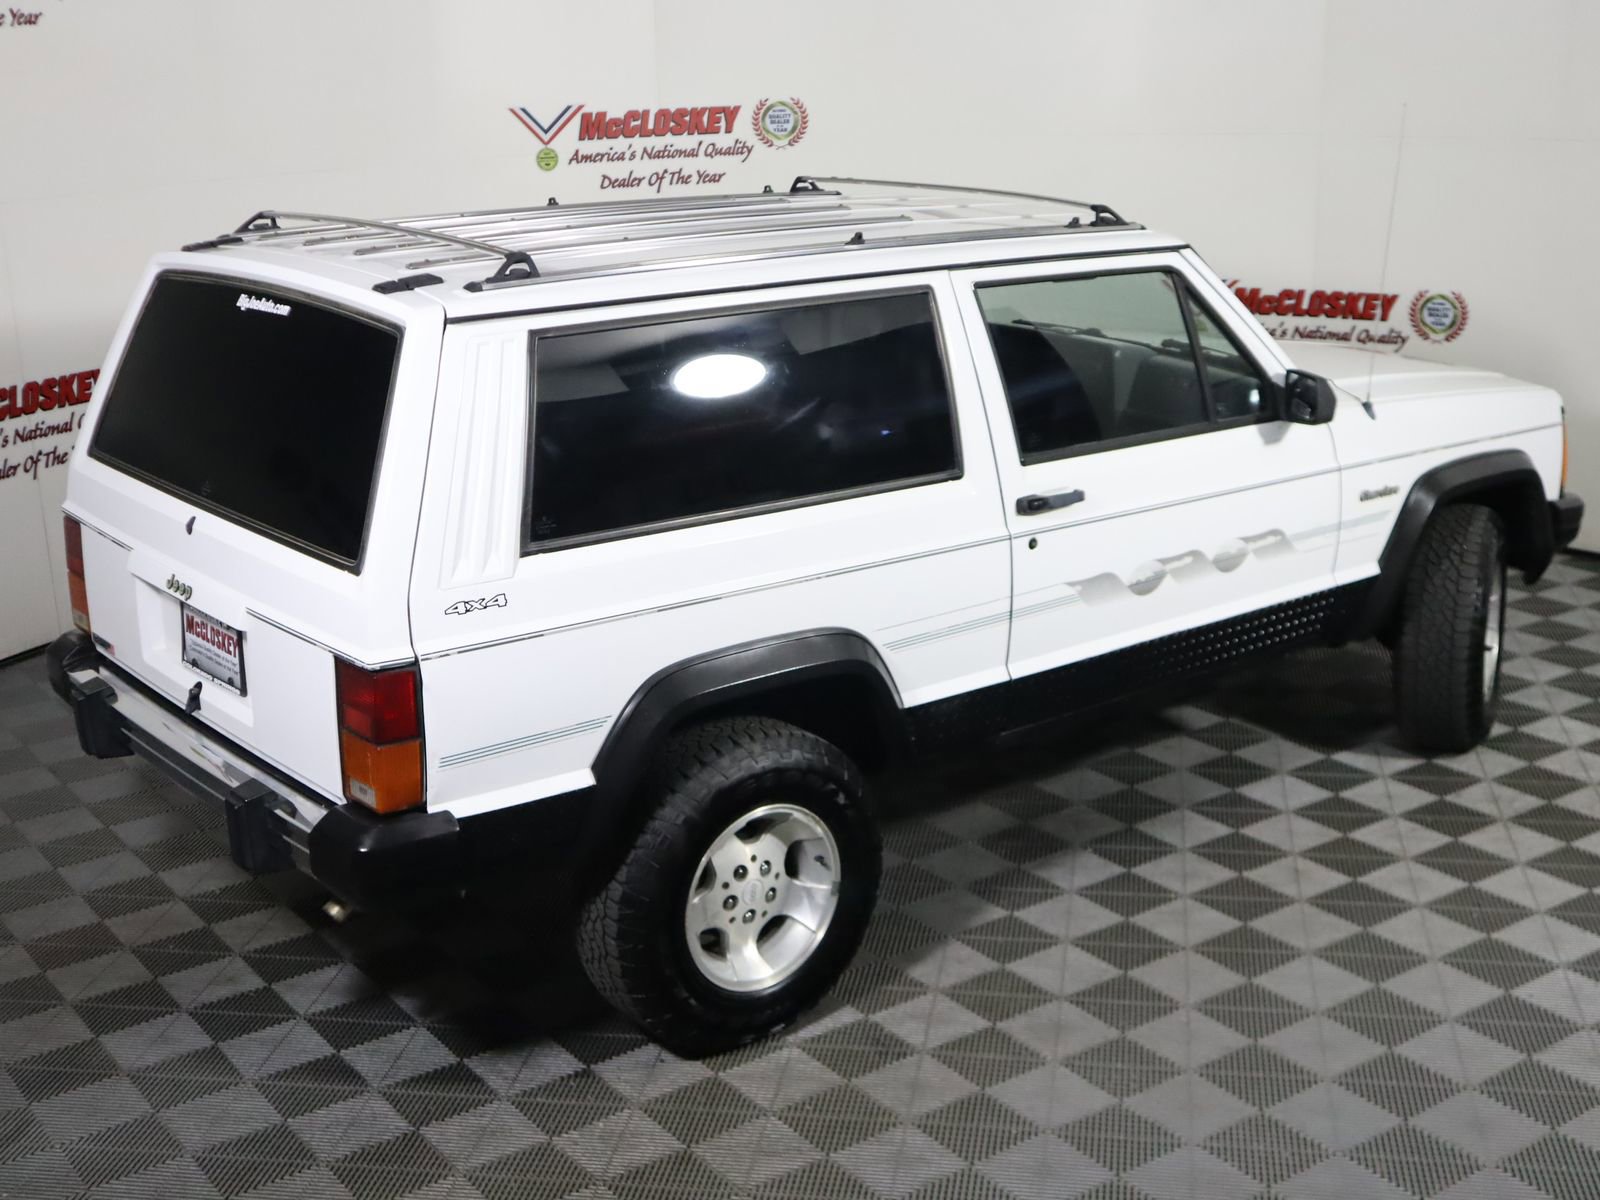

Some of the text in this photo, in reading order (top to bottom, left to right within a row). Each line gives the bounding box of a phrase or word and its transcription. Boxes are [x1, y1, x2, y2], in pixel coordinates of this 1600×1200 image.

[9, 8, 43, 27] Year
[578, 105, 742, 141] McCLOSKEY
[568, 145, 637, 164] America's
[641, 141, 703, 159] National
[704, 140, 754, 163] Quality
[600, 169, 727, 193] Dealer Of The Year
[1235, 287, 1399, 321] McCLOSKEY
[1293, 326, 1355, 342] National
[1356, 328, 1409, 352] Quality
[13, 411, 74, 445] National
[23, 450, 42, 480] Of
[44, 445, 68, 468] The
[166, 573, 193, 601] Jeep
[185, 613, 240, 658] McCLOSKEY
